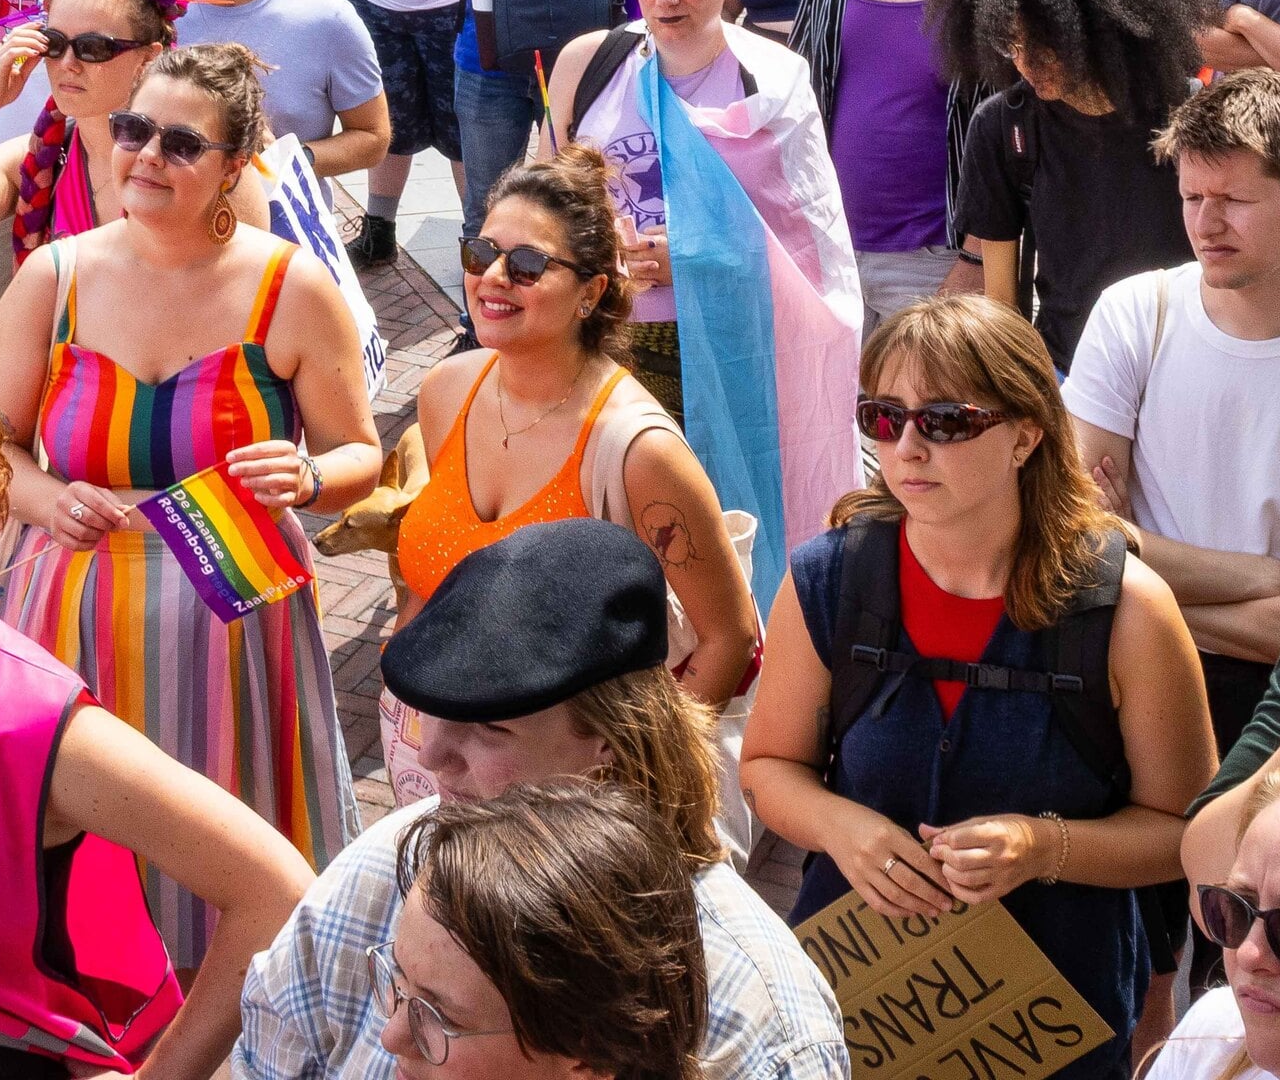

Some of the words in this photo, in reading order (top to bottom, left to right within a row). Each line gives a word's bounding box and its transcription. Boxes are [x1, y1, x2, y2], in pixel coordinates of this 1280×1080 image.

[157, 497, 215, 576] Regenboog
[172, 489, 191, 509] De
[189, 509, 225, 561] Zaanse
[232, 575, 306, 613] ZaanPride
[844, 945, 1005, 1069] TRANS
[937, 994, 1084, 1080] SAVE
